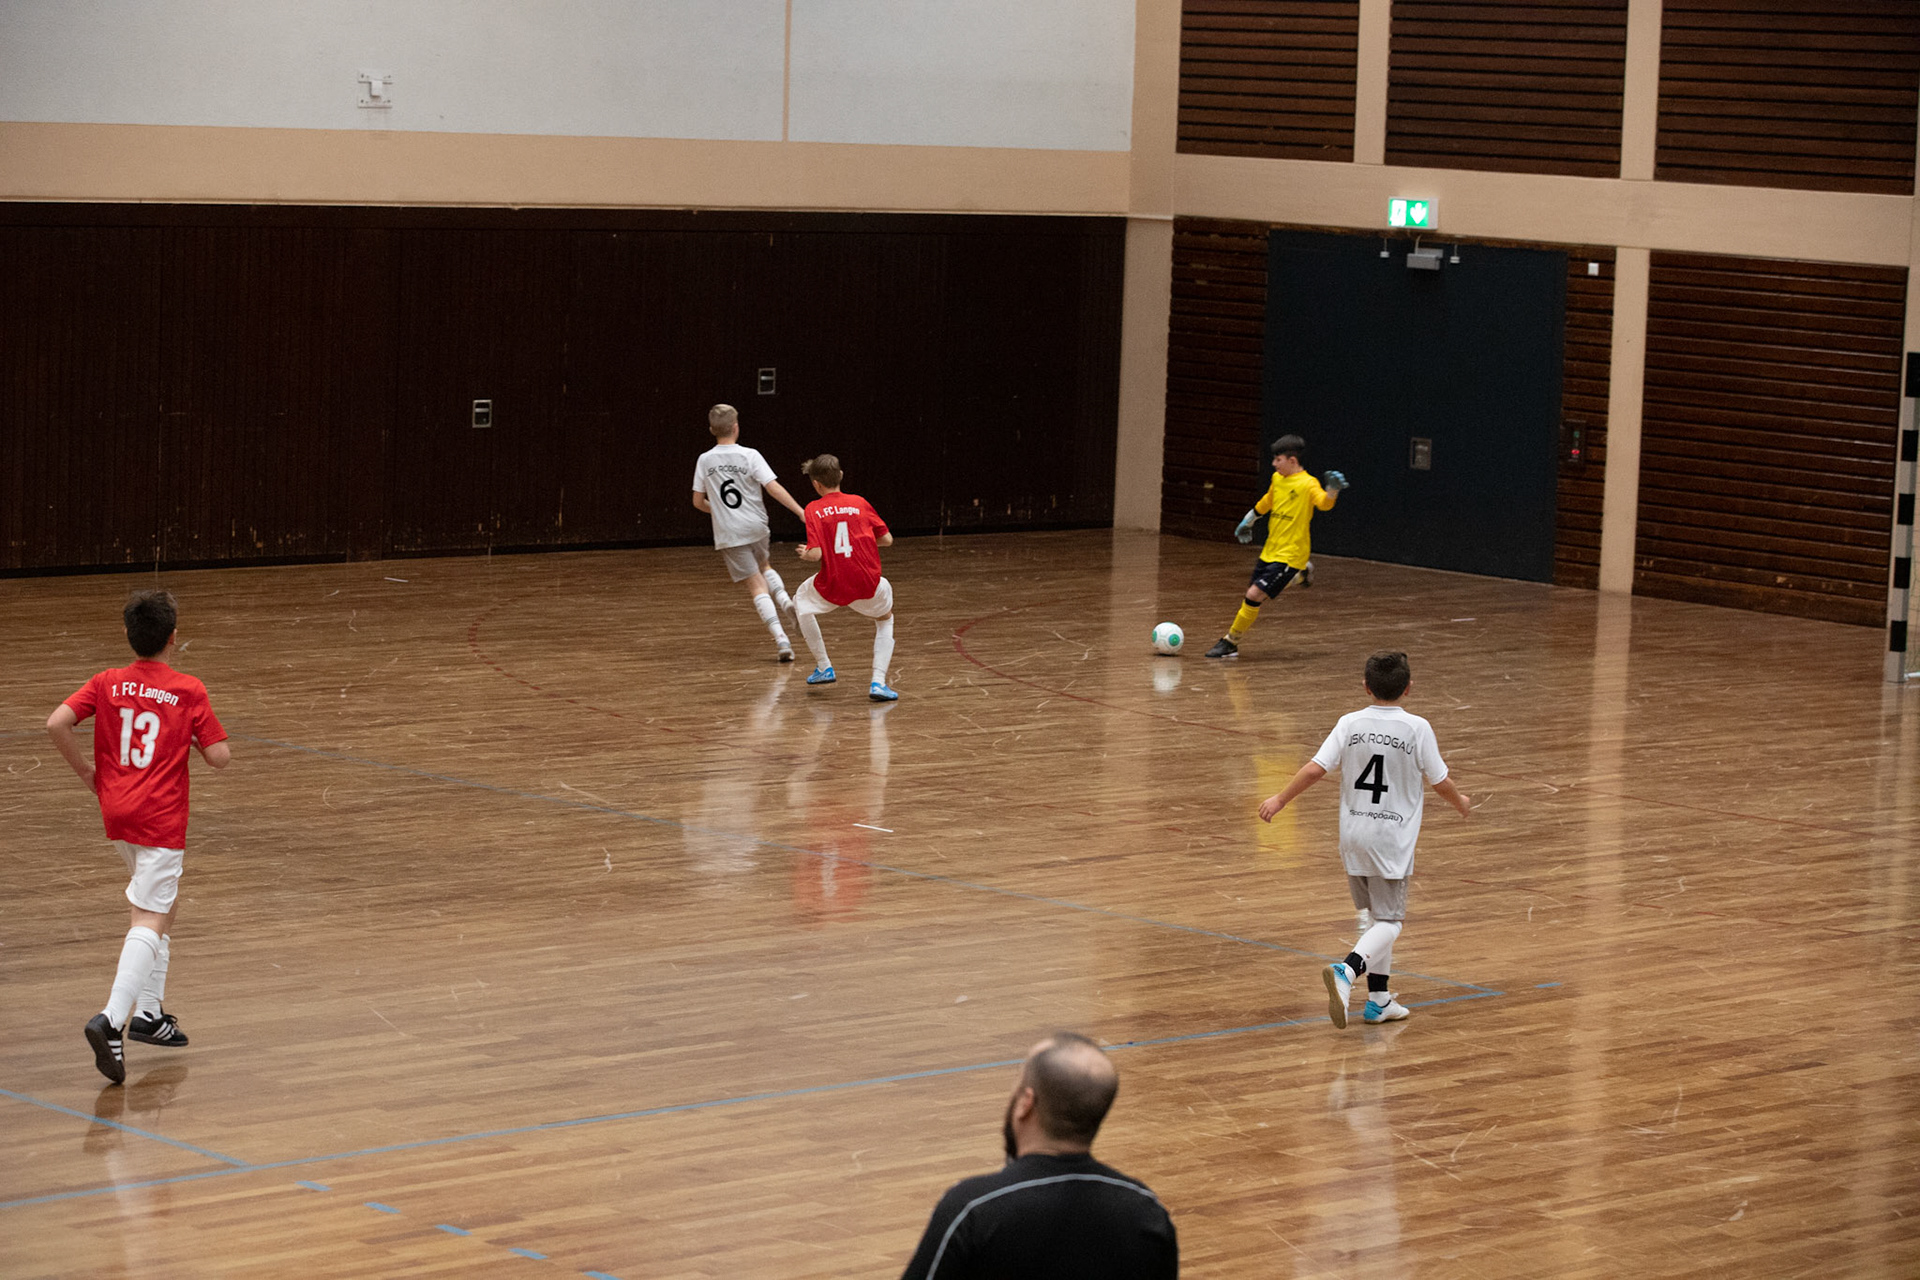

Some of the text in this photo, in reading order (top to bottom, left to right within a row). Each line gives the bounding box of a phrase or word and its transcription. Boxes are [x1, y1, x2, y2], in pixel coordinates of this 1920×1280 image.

[718, 465, 748, 475] RODGAU
[720, 479, 742, 509] 6
[815, 505, 860, 519] 1. FC Langen
[834, 521, 853, 558] 4
[112, 682, 179, 706] 1. FC Langen
[119, 707, 160, 769] 13
[1368, 733, 1414, 755] RODGAU
[1354, 753, 1389, 804] 4
